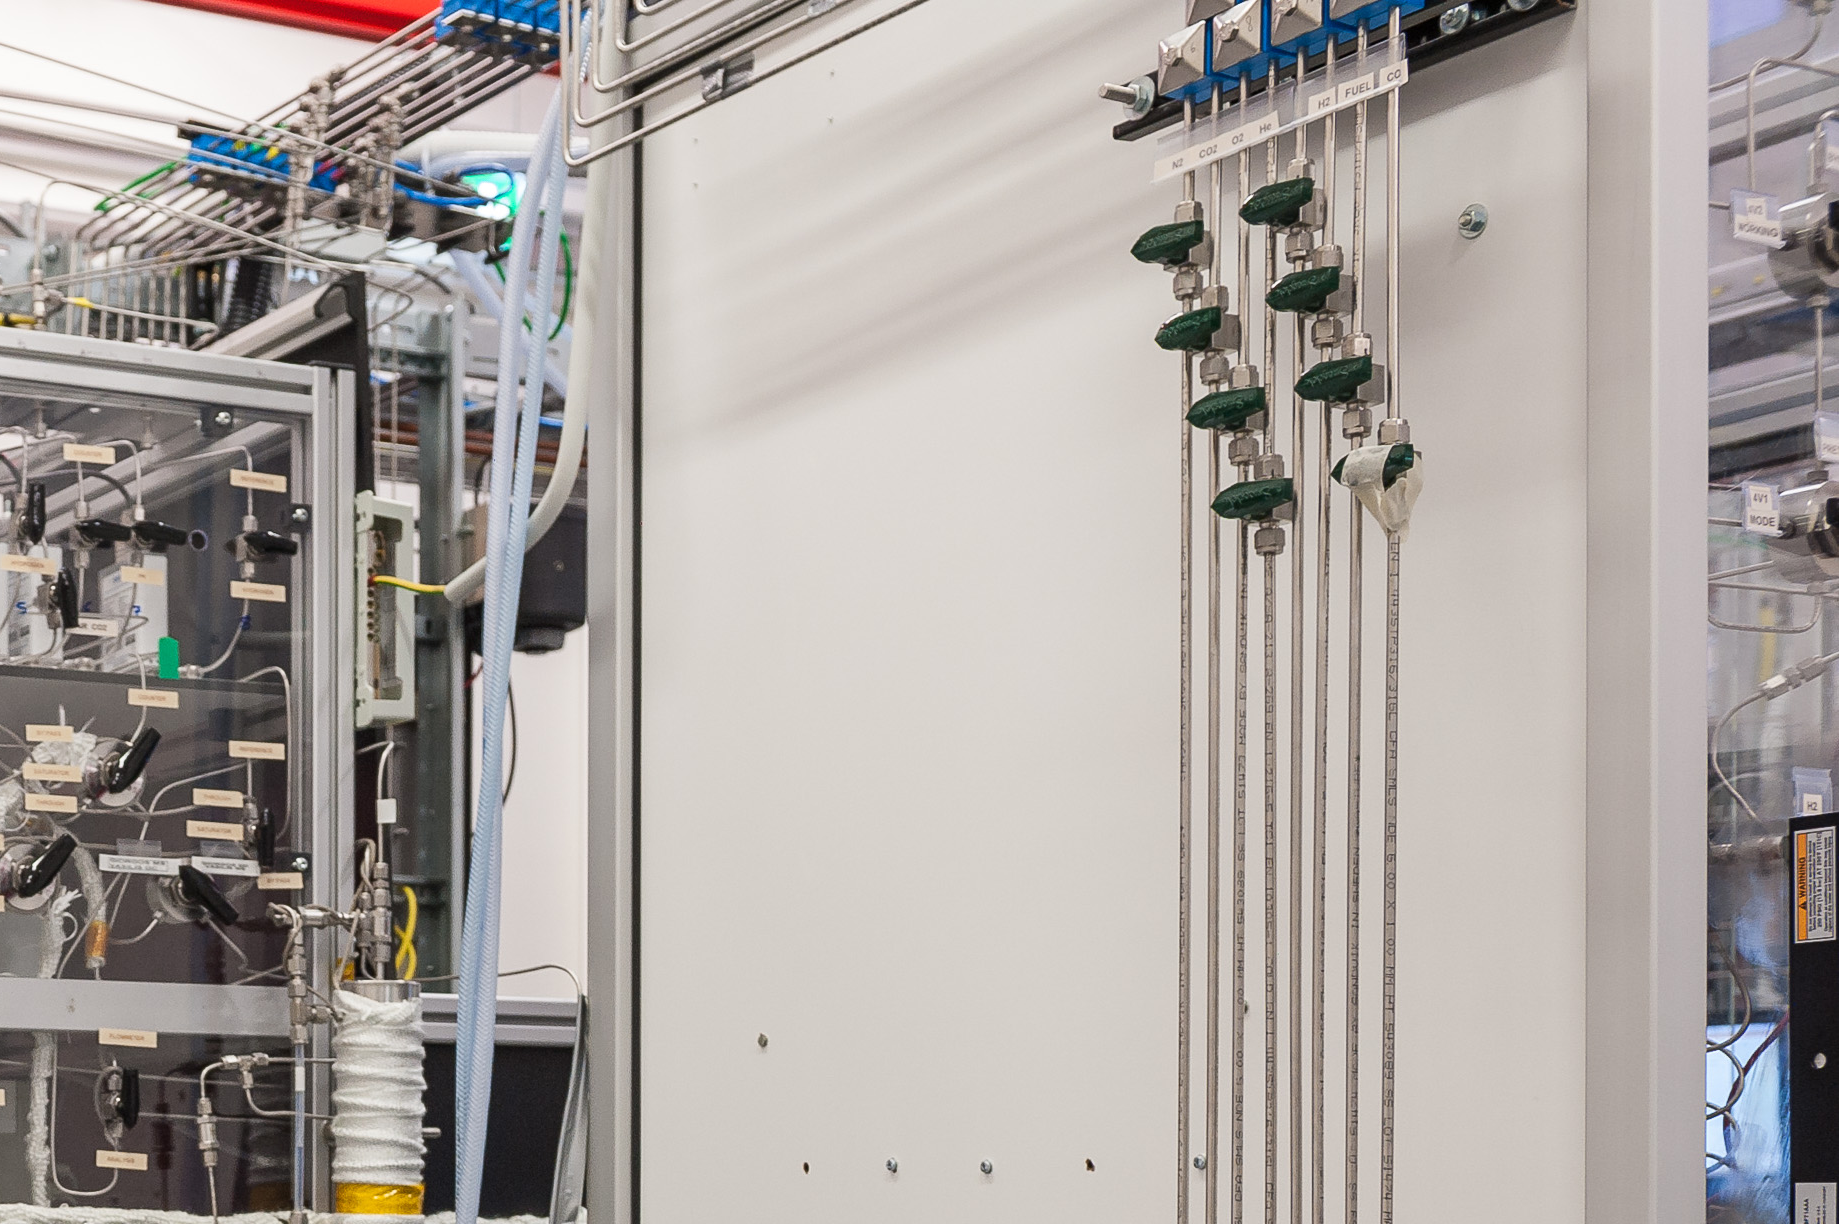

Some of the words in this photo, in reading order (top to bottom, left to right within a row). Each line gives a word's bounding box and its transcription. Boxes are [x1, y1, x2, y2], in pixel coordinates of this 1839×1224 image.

[1386, 69, 1401, 82] CO
[1345, 82, 1371, 98] FUEL
[1318, 97, 1330, 109] H2
[1232, 134, 1244, 145] O2
[1199, 145, 1218, 159] CO2
[1172, 158, 1184, 170] N2
[1750, 514, 1775, 526] MODE
[1807, 801, 1818, 812] H2
